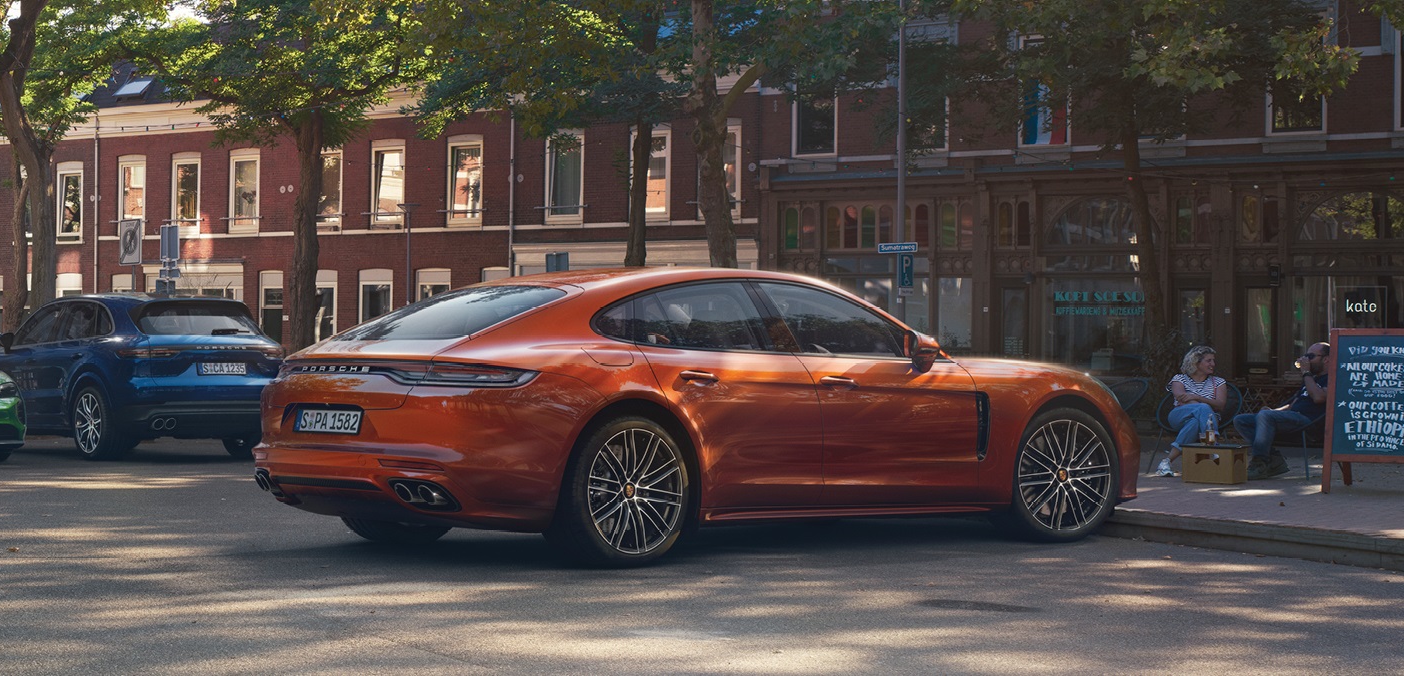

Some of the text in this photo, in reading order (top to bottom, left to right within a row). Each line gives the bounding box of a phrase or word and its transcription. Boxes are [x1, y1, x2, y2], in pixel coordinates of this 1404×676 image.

[903, 256, 911, 273] P
[1054, 291, 1089, 302] KOPI
[203, 364, 245, 373] S CA 1235
[1372, 380, 1404, 388] MADE
[300, 412, 359, 431] S PA 1582
